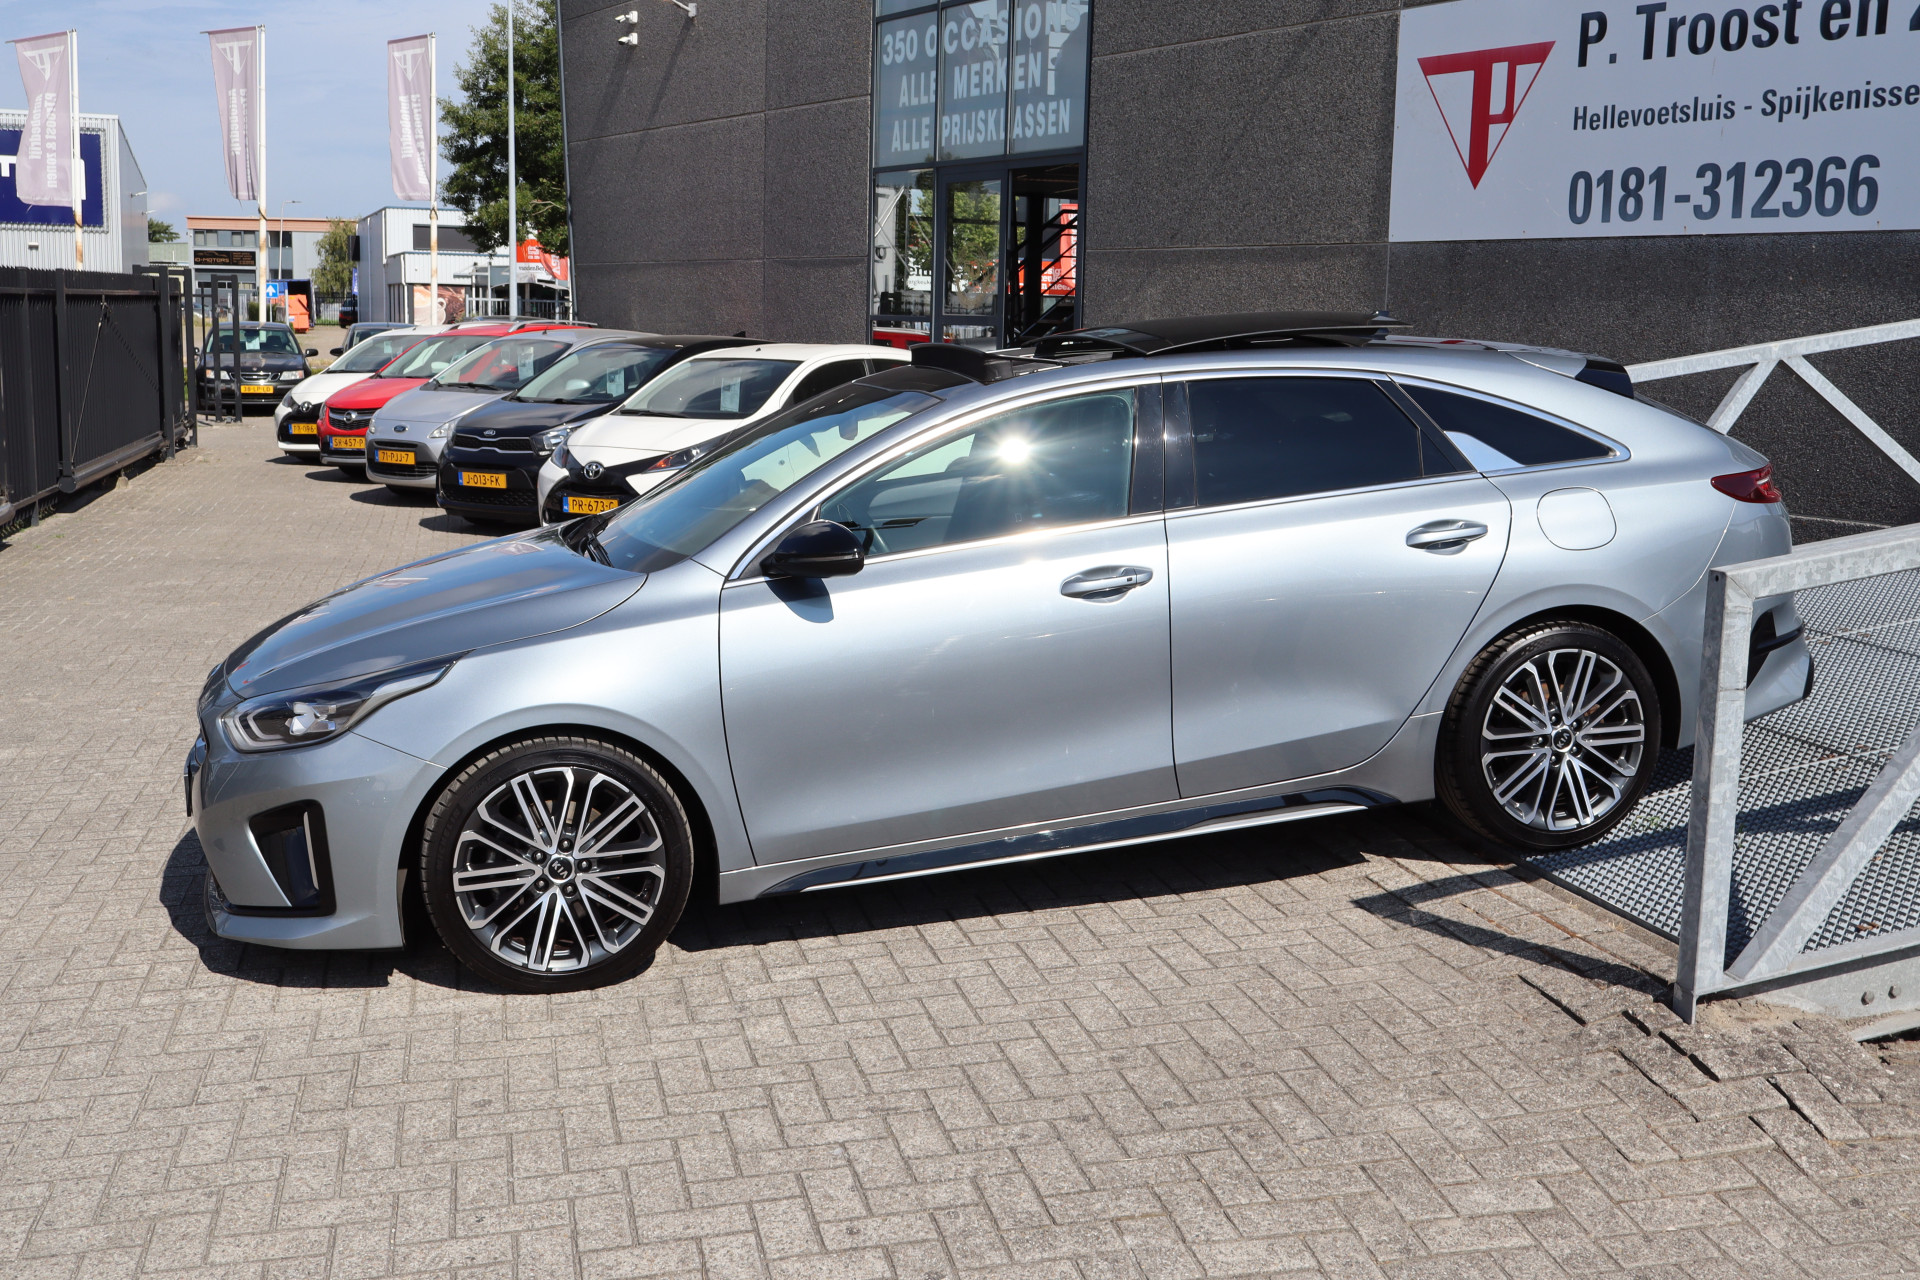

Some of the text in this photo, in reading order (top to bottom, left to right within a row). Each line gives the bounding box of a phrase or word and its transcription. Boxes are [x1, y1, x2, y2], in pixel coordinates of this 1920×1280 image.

[882, 0, 1082, 67] 350 OCCASIONS
[1577, 10, 1618, 68] P.
[1635, 0, 1803, 61] Troost
[1819, 0, 1890, 41] en
[898, 51, 1042, 108] ALLE MERKEN
[1572, 93, 1736, 131] Hellevoetsluis
[1760, 80, 1920, 123] Spijkenisse
[891, 98, 1071, 153] ALLE PRIJSKLASSEN
[1567, 153, 1881, 225] 0181-312366
[466, 474, 501, 487] J-013-FK
[551, 860, 569, 879] KIA
